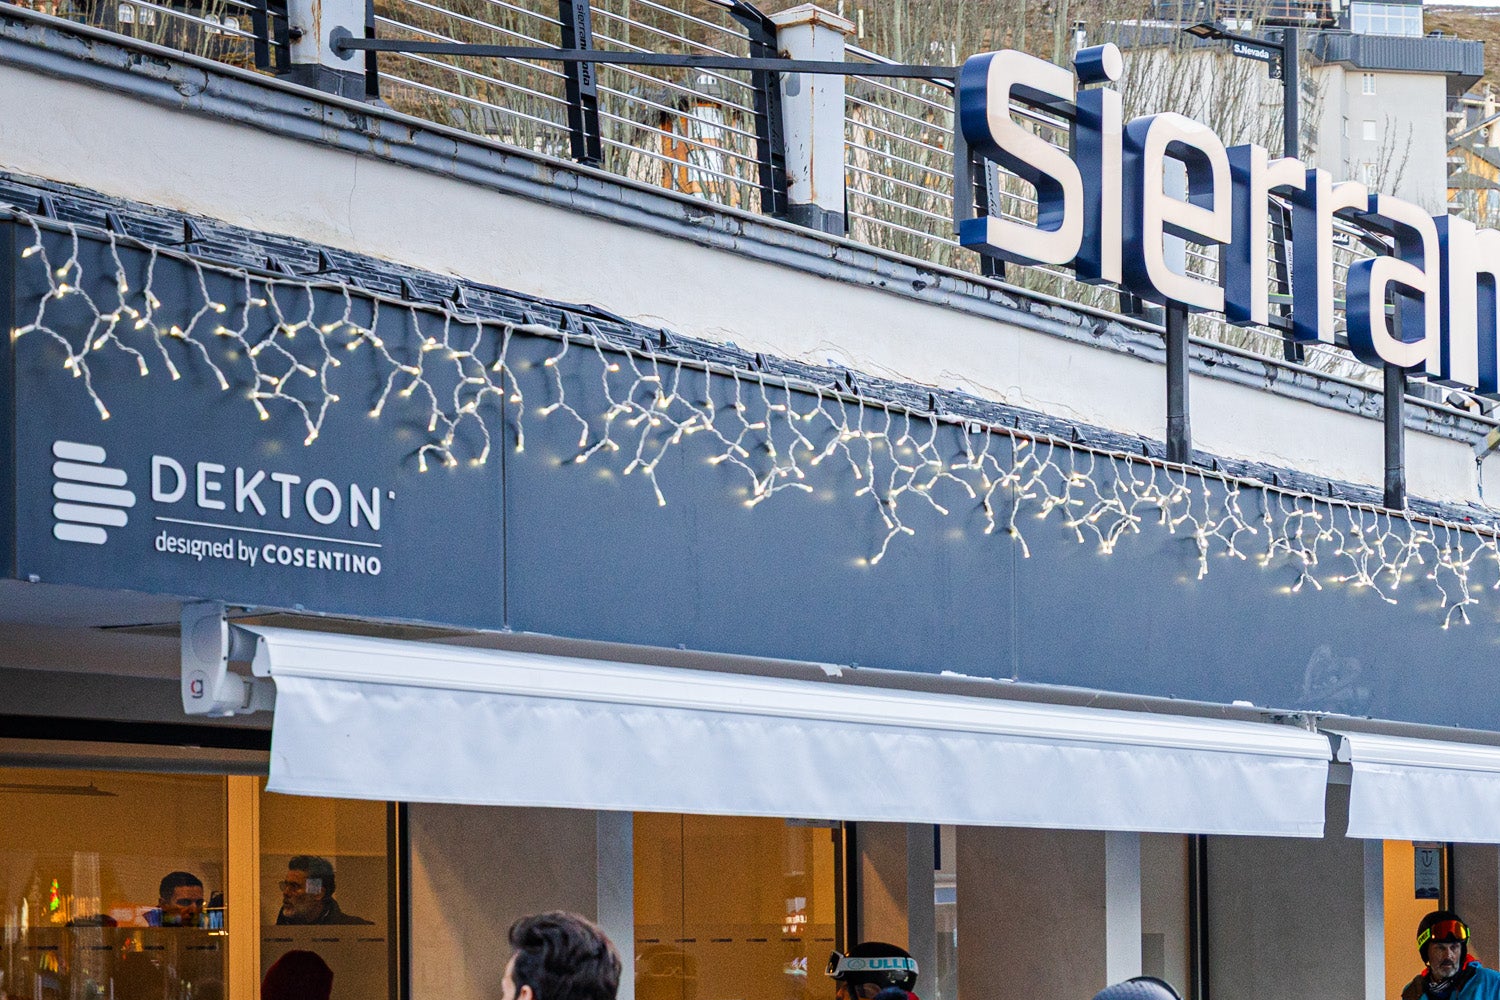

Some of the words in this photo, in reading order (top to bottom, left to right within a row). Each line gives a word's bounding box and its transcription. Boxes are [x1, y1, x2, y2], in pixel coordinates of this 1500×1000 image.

[152, 455, 381, 531] DEKTON
[155, 530, 234, 561] designed
[238, 539, 259, 567] by
[262, 544, 382, 576] COSENTINO
